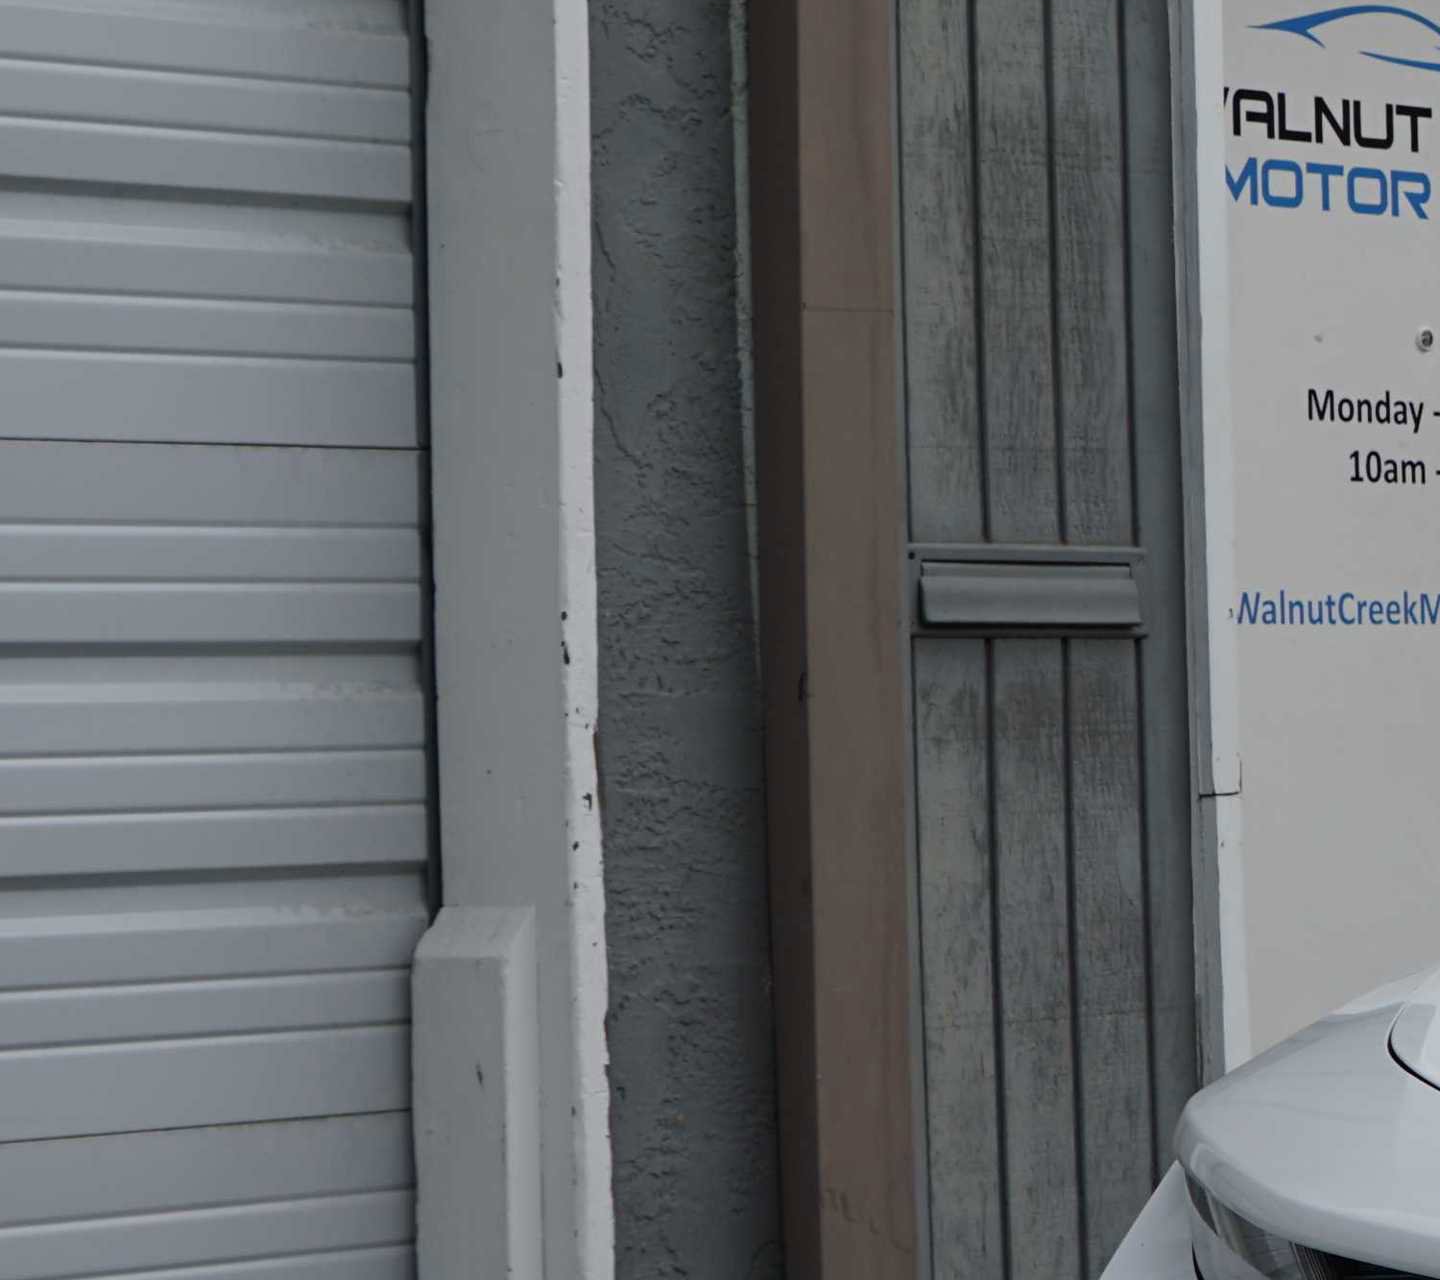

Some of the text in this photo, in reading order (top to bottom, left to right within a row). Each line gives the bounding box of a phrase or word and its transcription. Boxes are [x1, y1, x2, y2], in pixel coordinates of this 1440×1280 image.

[1224, 86, 1433, 153] ALNUT
[1225, 157, 1431, 220] MOTOR
[1307, 388, 1424, 434] Monday
[1349, 450, 1426, 485] 10am
